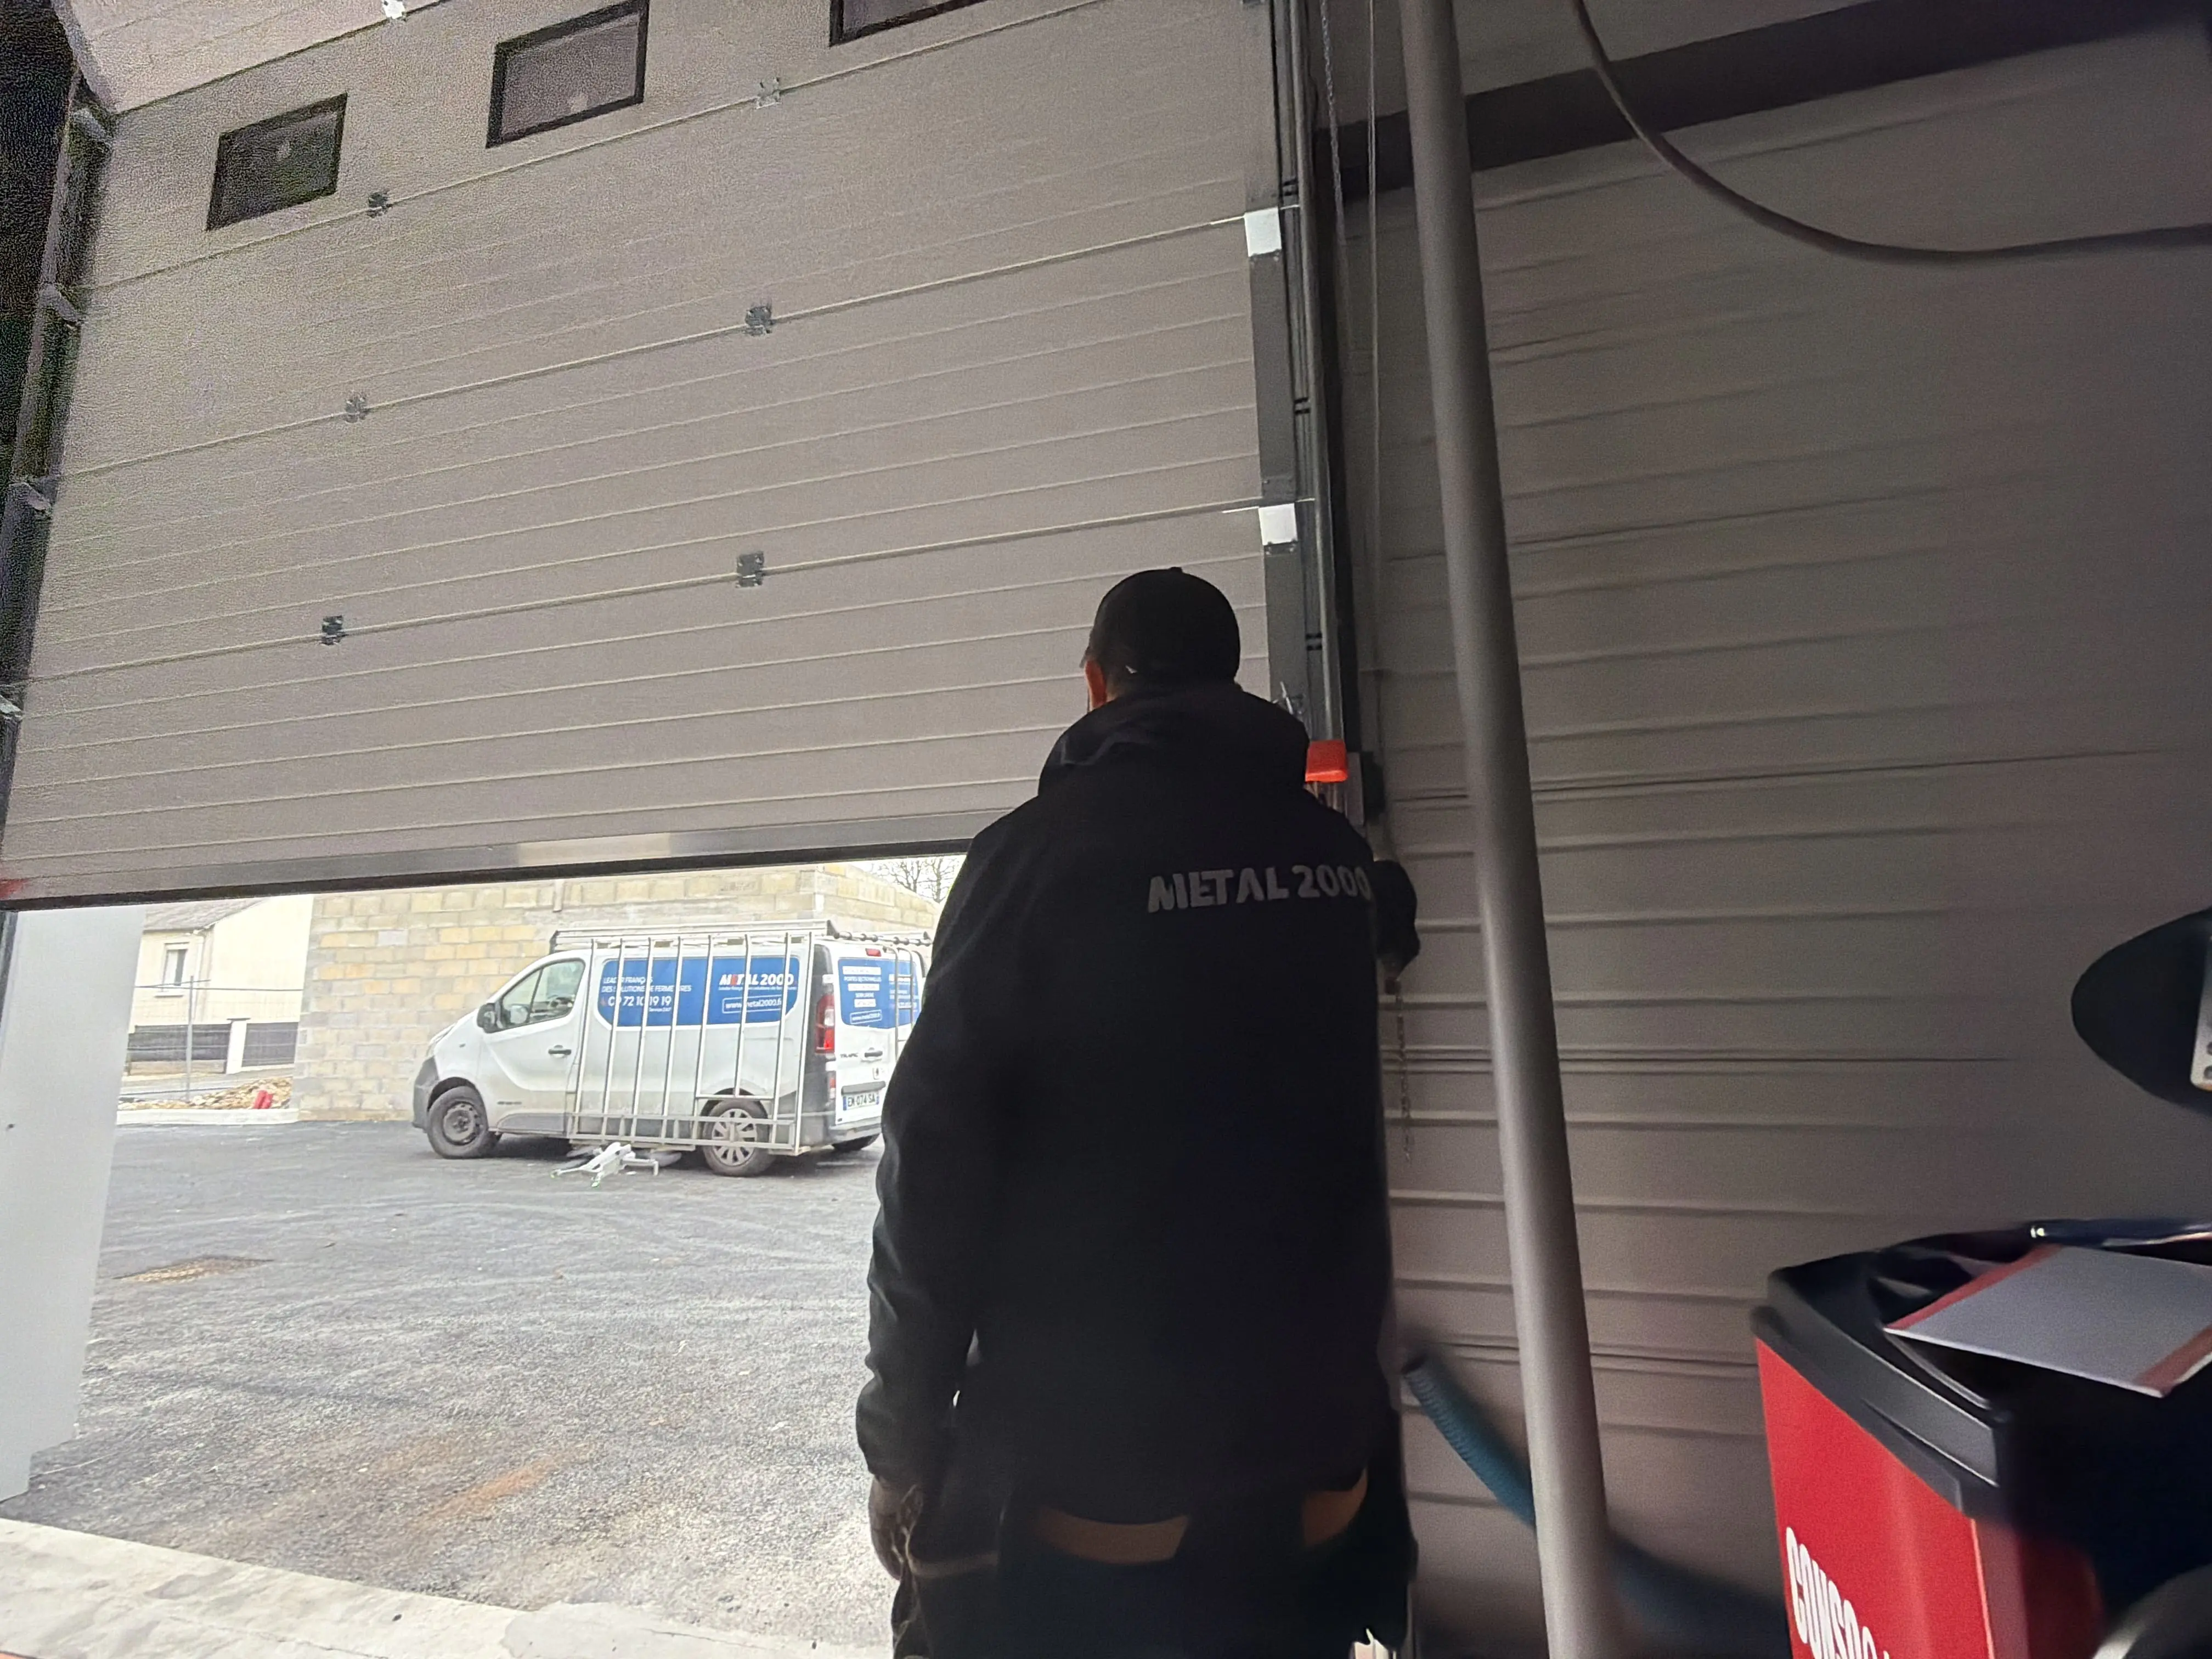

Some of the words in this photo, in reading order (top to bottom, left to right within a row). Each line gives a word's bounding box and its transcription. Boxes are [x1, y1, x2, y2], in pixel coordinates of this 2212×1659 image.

[1148, 867, 1290, 913] METAL
[1292, 864, 1372, 901] 2000
[760, 974, 794, 985] 2000
[623, 996, 635, 1006] 72
[649, 996, 659, 1006] 19
[661, 996, 672, 1006] 19
